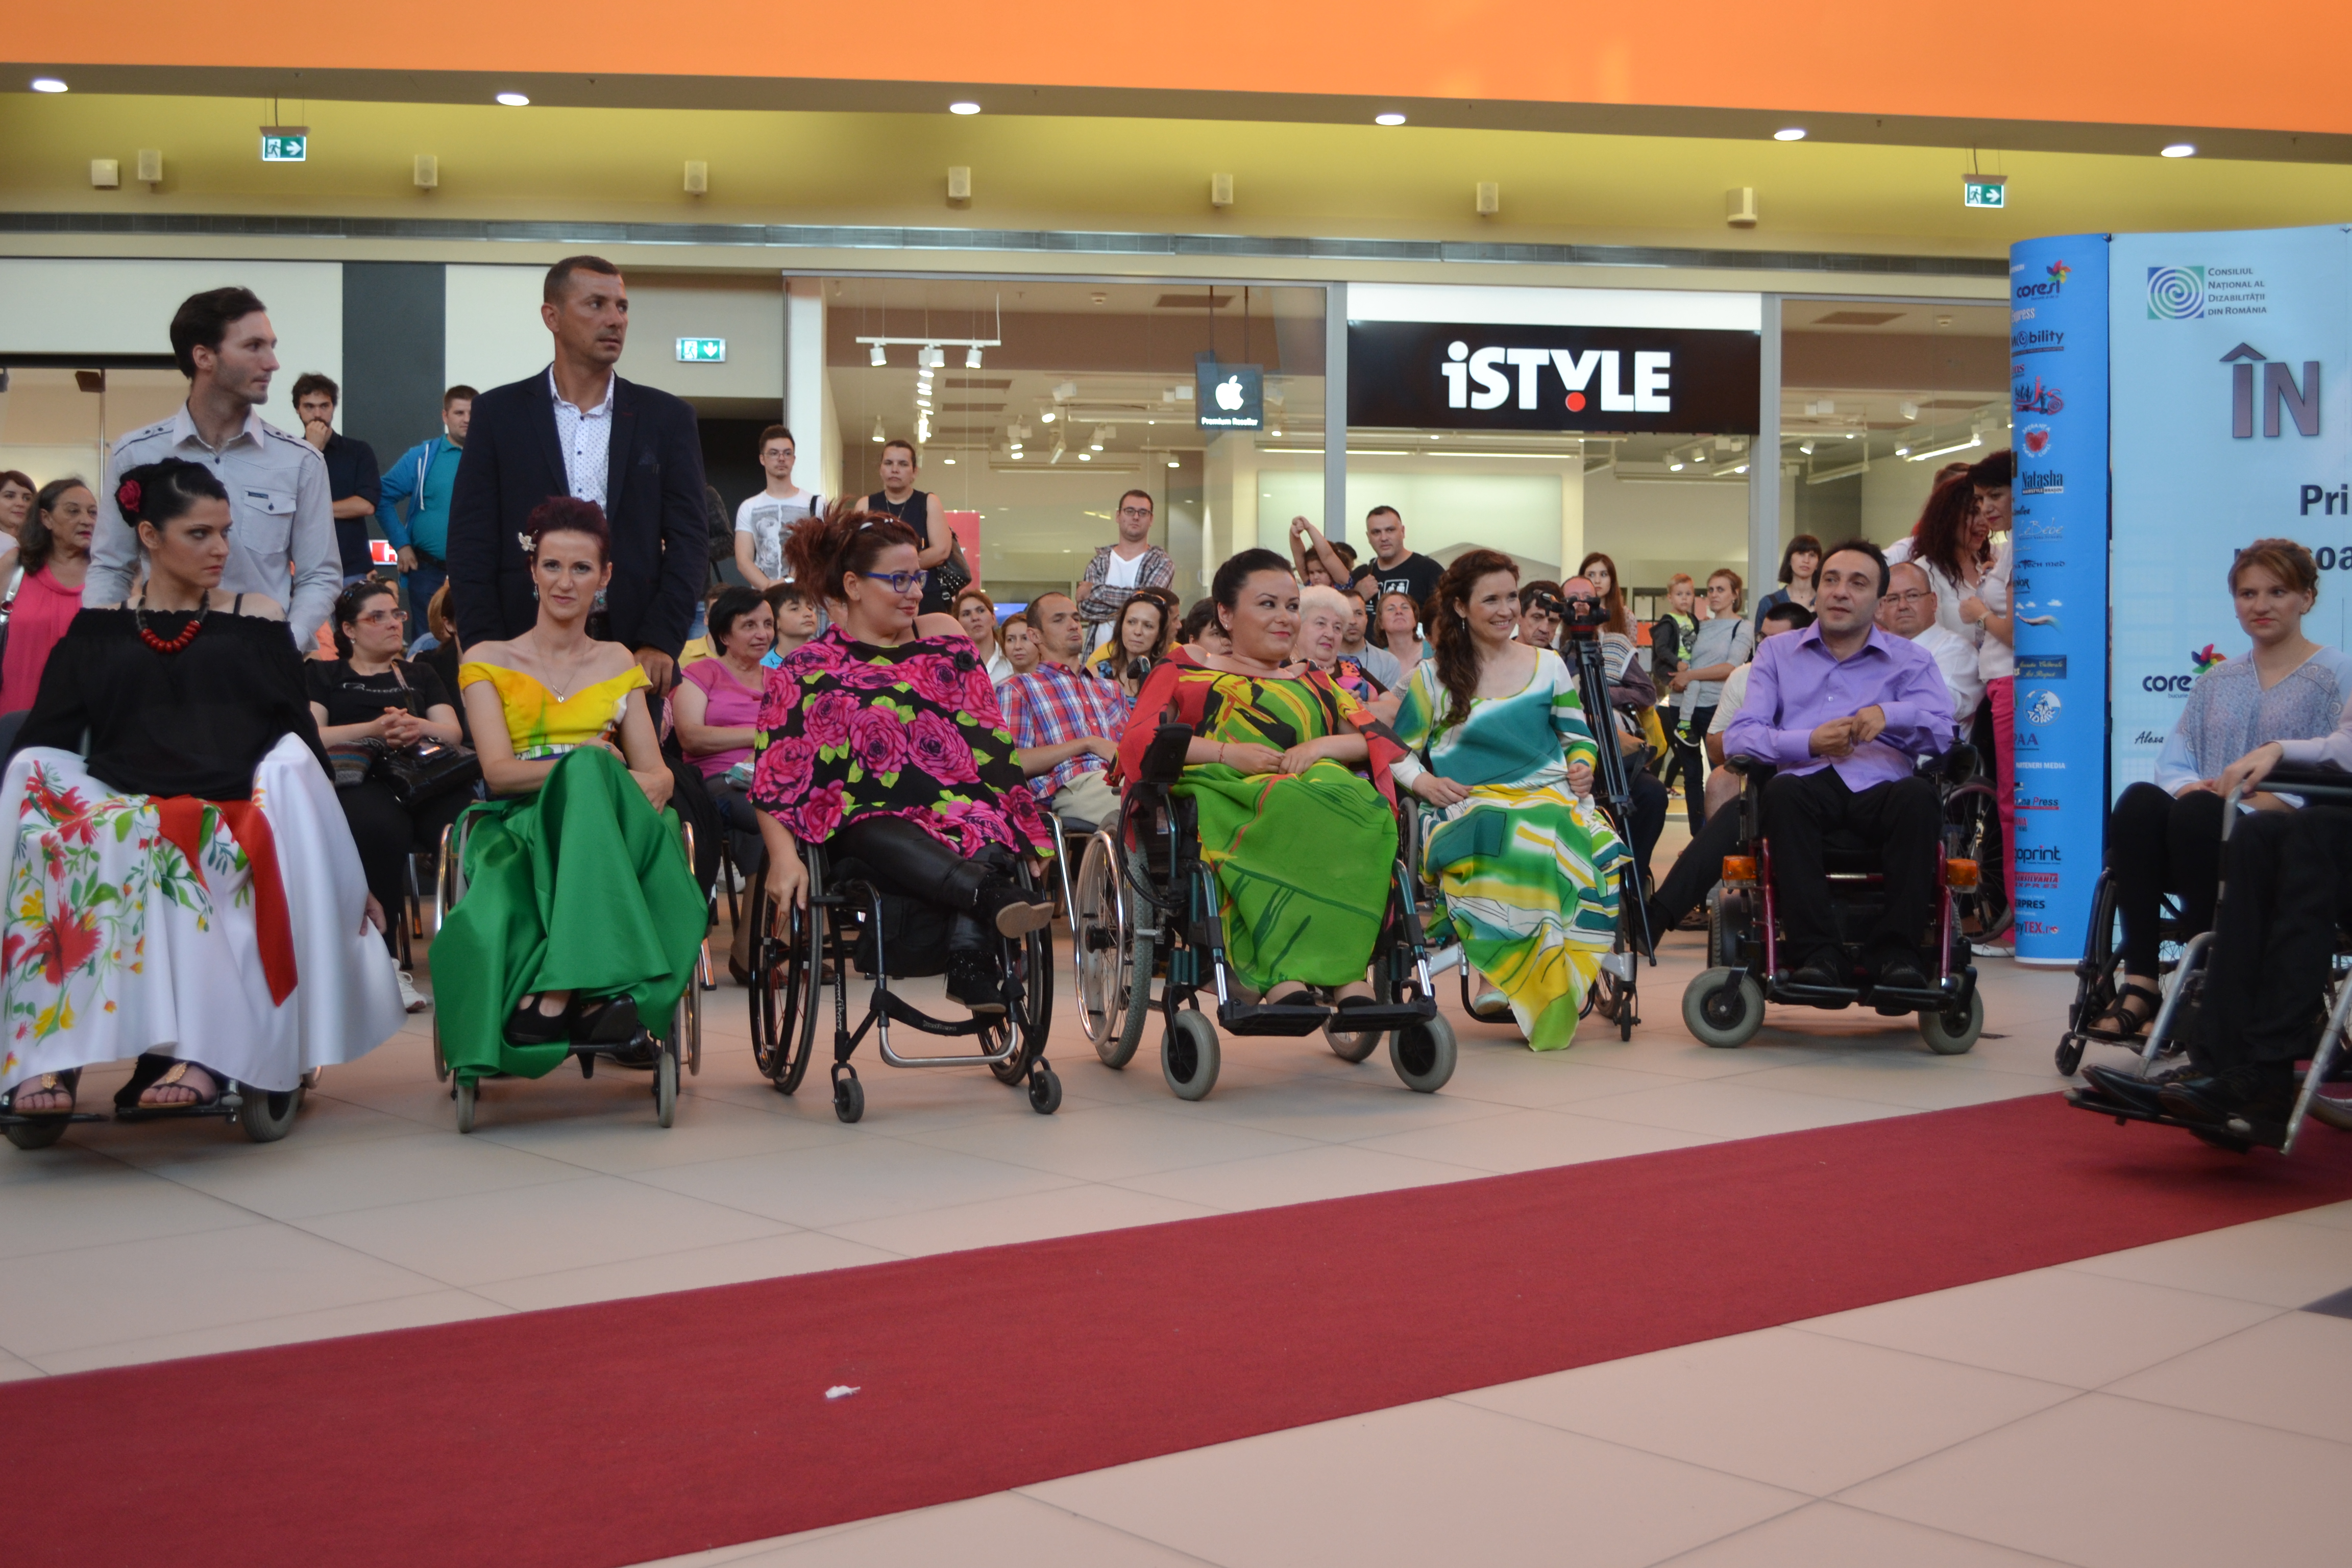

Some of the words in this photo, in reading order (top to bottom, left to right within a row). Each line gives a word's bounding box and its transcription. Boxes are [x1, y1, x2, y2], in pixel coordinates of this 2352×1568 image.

[2208, 268, 2253, 276] CONSILIUL
[1442, 340, 1671, 412] iSTYLE
[2022, 470, 2063, 489] Natasha
[2142, 675, 2193, 692] core
[2135, 731, 2164, 744] Alexa
[2033, 796, 2059, 806] Press
